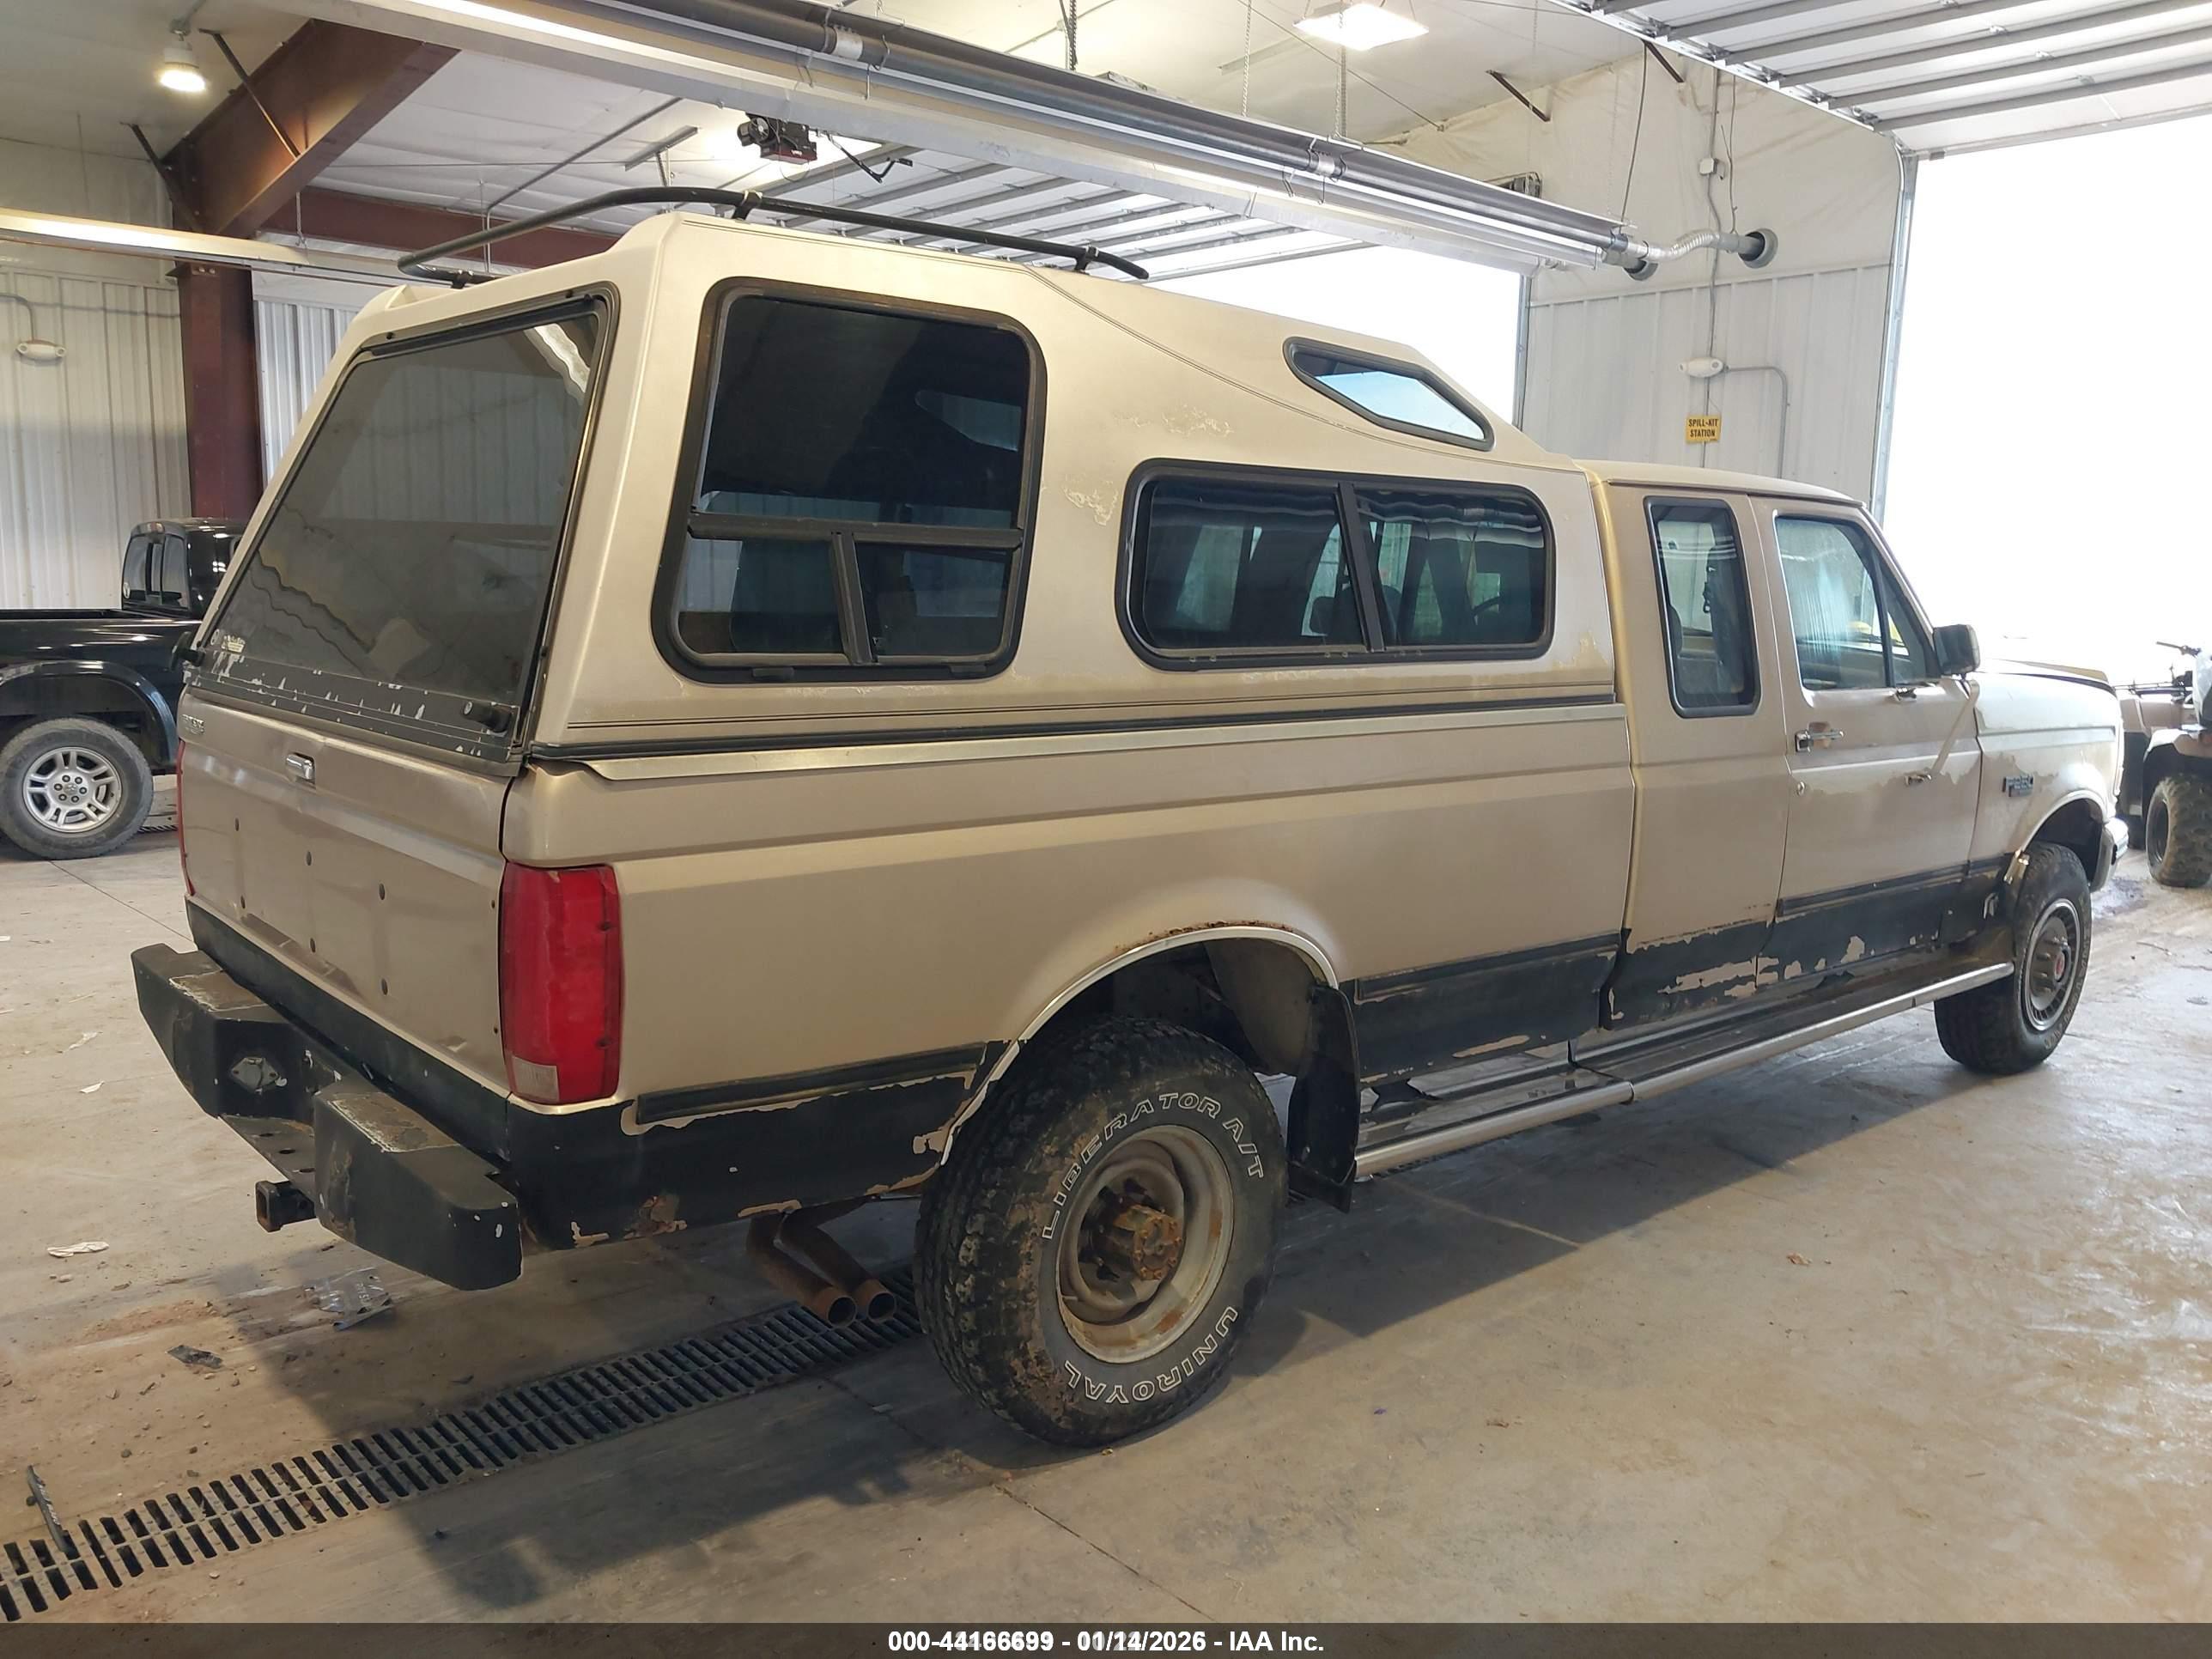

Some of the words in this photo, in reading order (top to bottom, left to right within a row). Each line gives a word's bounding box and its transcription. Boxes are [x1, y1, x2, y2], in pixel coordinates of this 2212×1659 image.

[1688, 418, 1719, 428] SPILL-KIT
[1690, 428, 1716, 438] STATION
[1042, 1092, 1221, 1239] LIBERATOR
[1064, 1306, 1238, 1404] UNIROYAL
